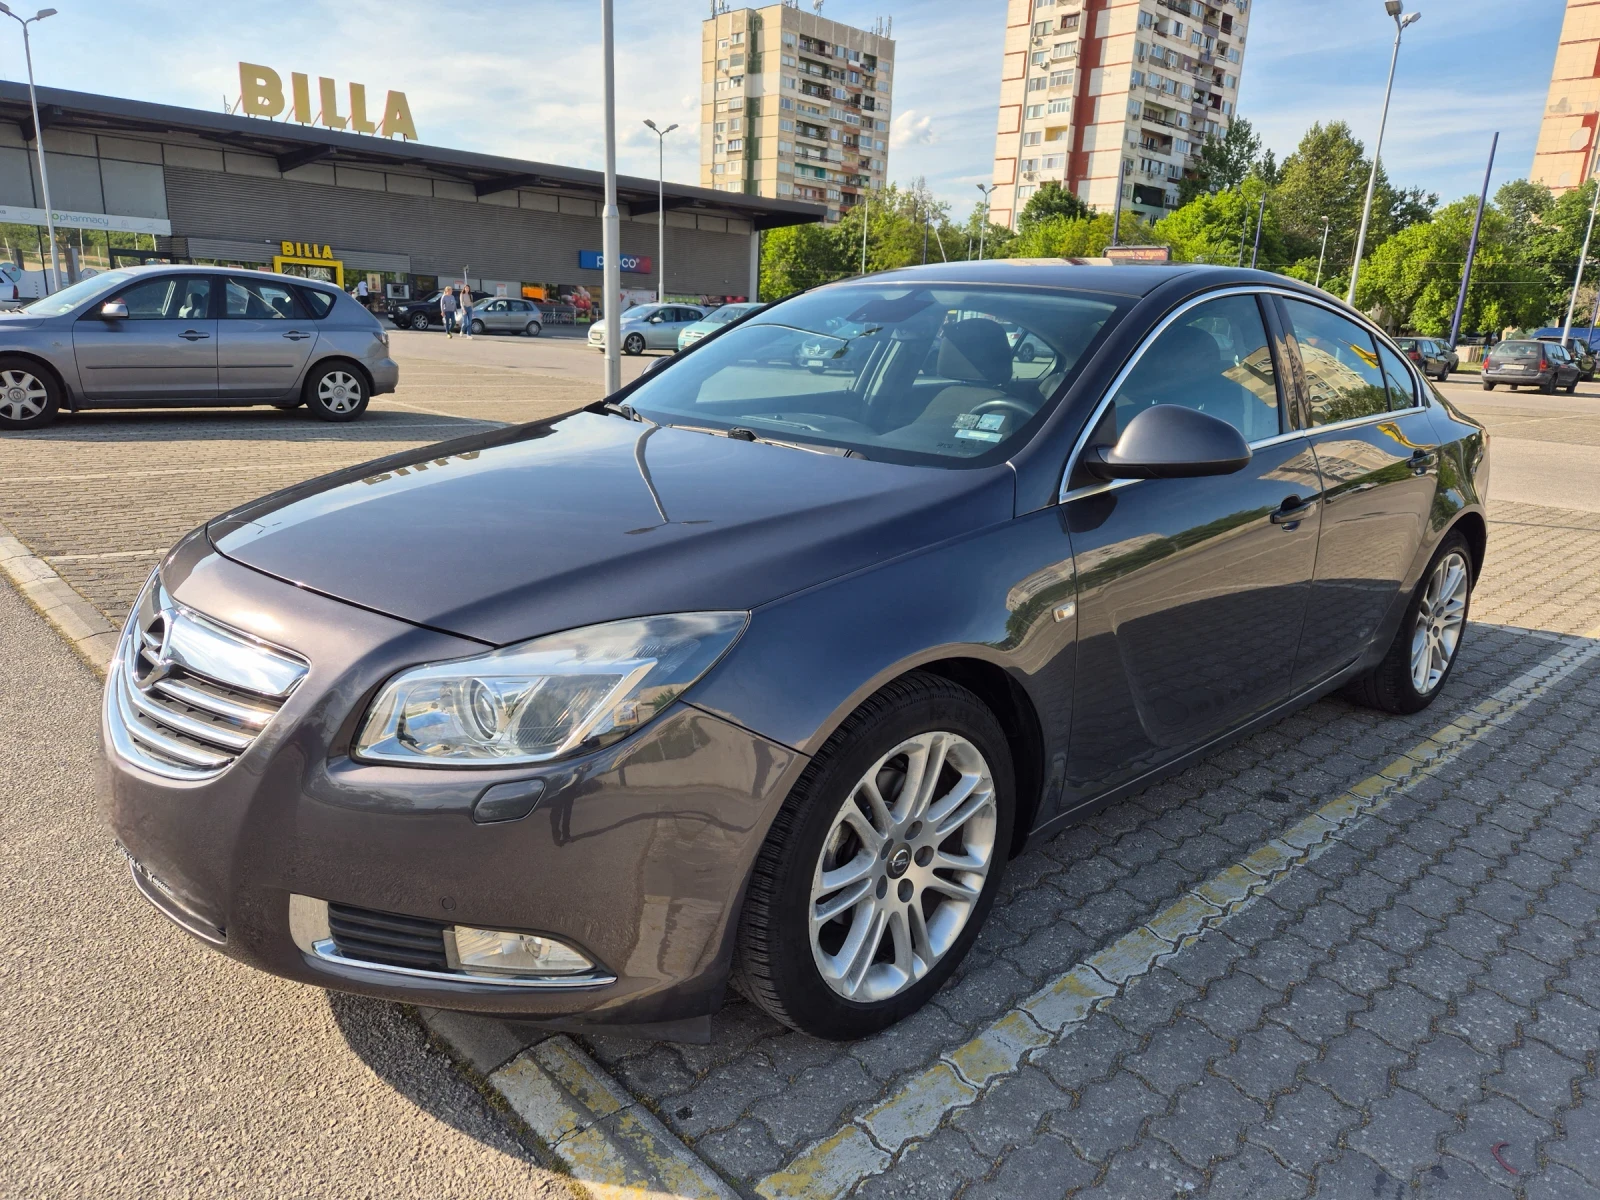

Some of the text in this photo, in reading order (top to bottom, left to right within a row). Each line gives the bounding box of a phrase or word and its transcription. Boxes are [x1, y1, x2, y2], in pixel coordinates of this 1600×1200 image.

[239, 62, 418, 140] BILLA
[46, 212, 109, 226] opharmacy
[282, 241, 333, 259] BILLA
[597, 256, 636, 268] pco
